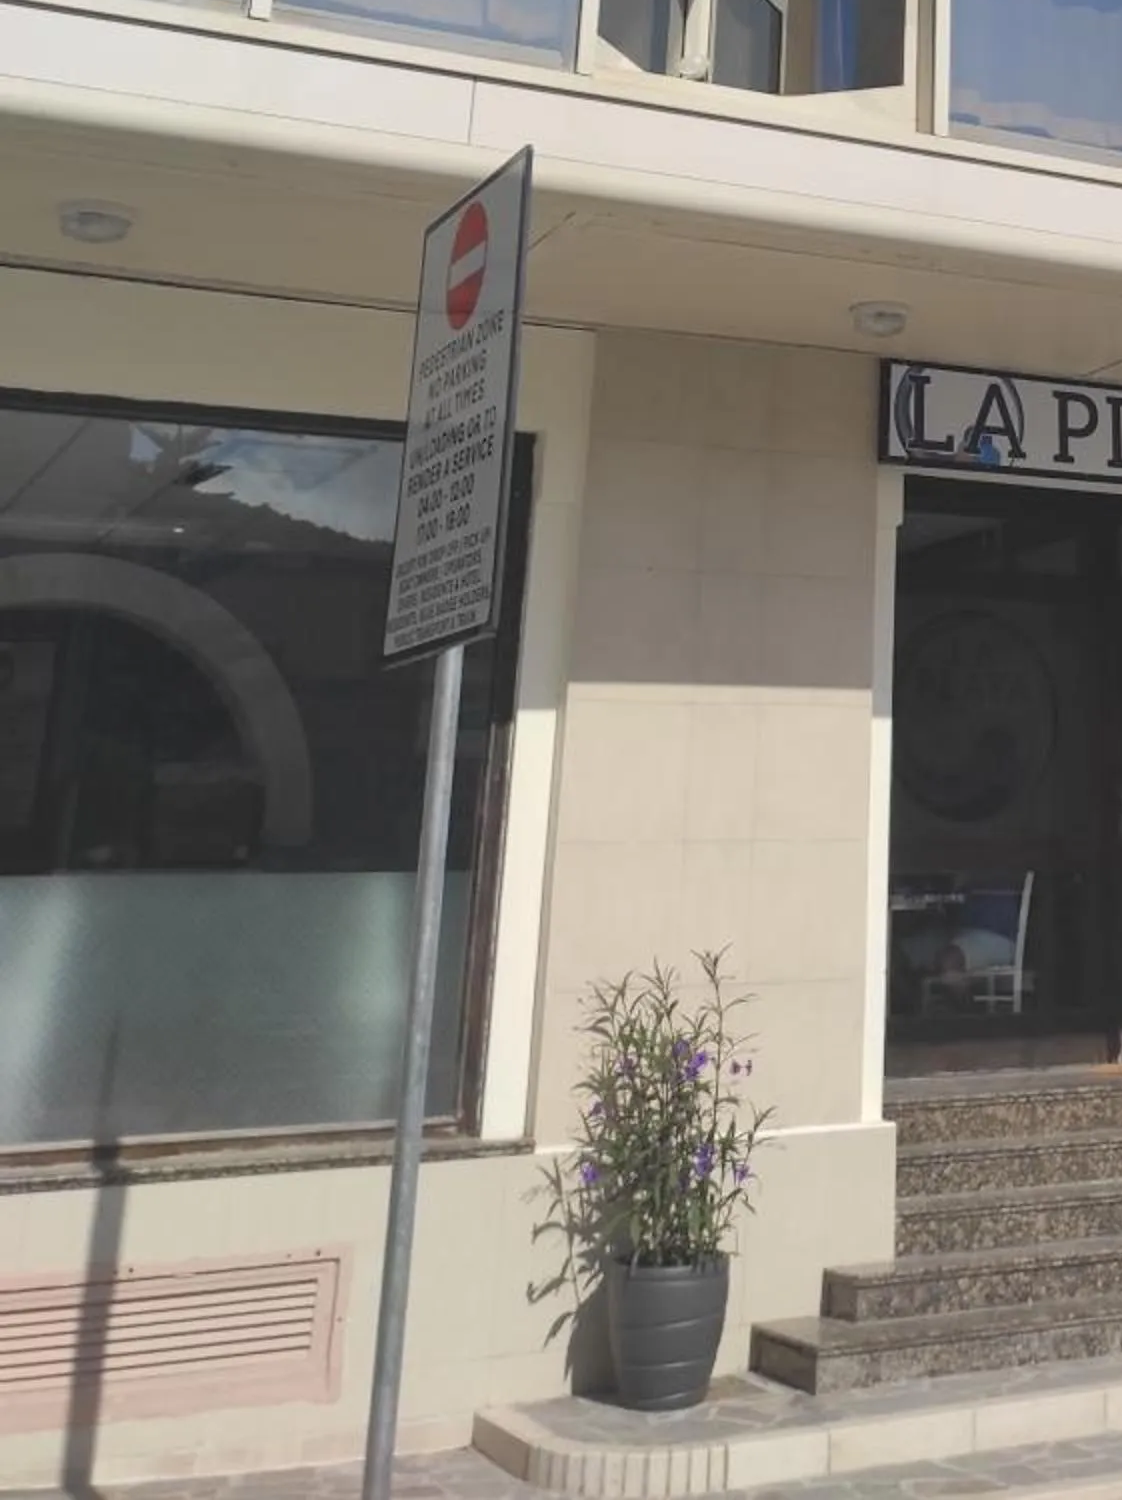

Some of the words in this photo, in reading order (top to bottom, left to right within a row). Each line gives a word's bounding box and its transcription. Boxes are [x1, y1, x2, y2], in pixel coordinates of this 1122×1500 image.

[418, 327, 474, 384] PEDESTRIAN
[476, 308, 504, 344] ZONE
[427, 376, 441, 400] NO
[443, 349, 486, 392] PARKING
[425, 405, 436, 429] AT
[437, 397, 452, 420] ALL
[455, 378, 484, 413] TIMES
[467, 412, 481, 439] OR
[484, 404, 497, 431] TO
[908, 374, 1027, 459] LA
[407, 461, 442, 498] RENDER
[452, 433, 494, 474] SERVICE
